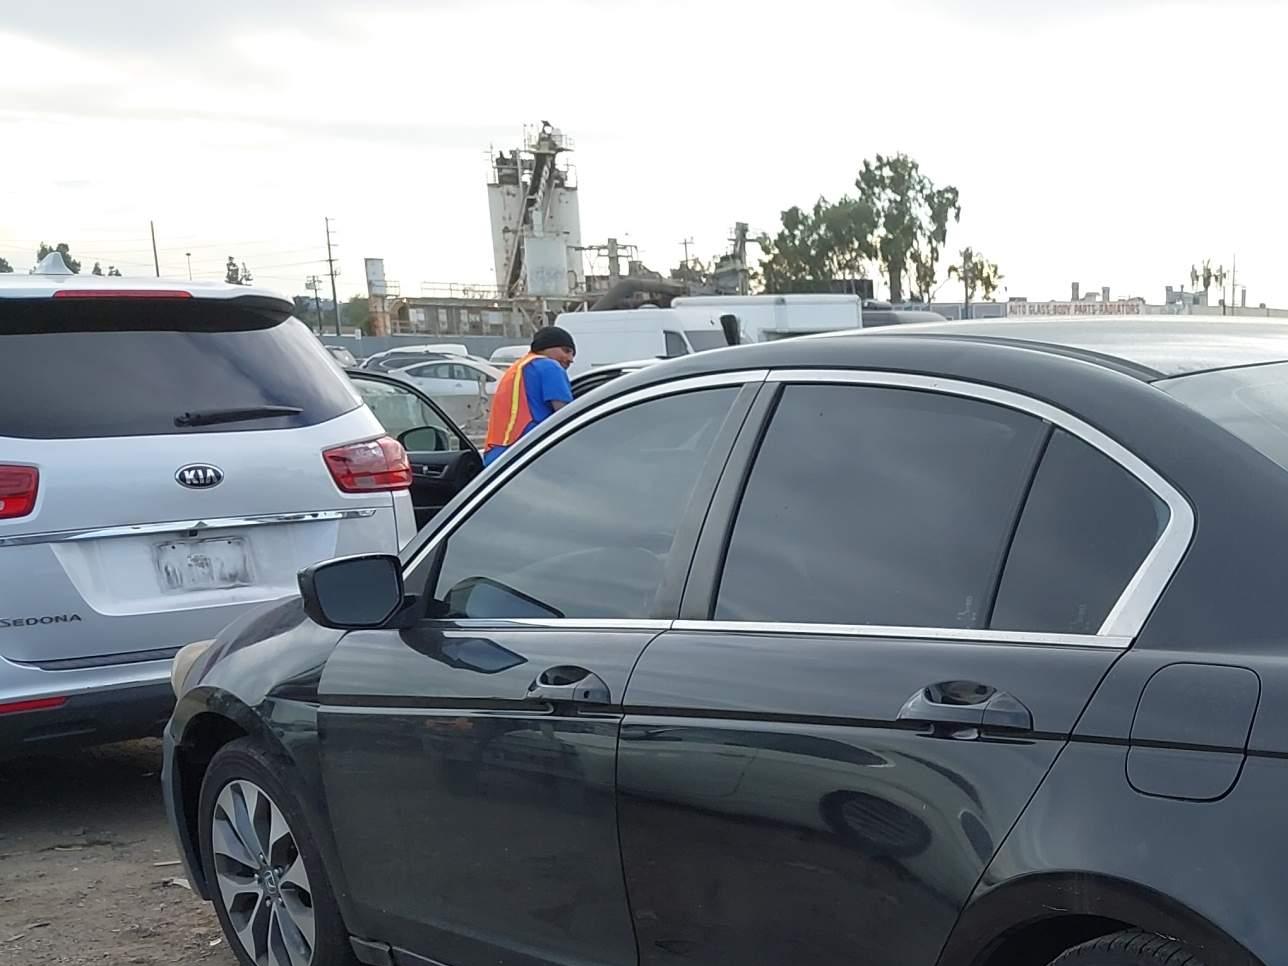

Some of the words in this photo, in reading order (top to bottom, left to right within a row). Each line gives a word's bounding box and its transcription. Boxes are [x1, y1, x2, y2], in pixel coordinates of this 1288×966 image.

[1009, 303, 1026, 315] AUTO
[183, 468, 218, 484] KIA
[0, 614, 82, 628] SEDONA
